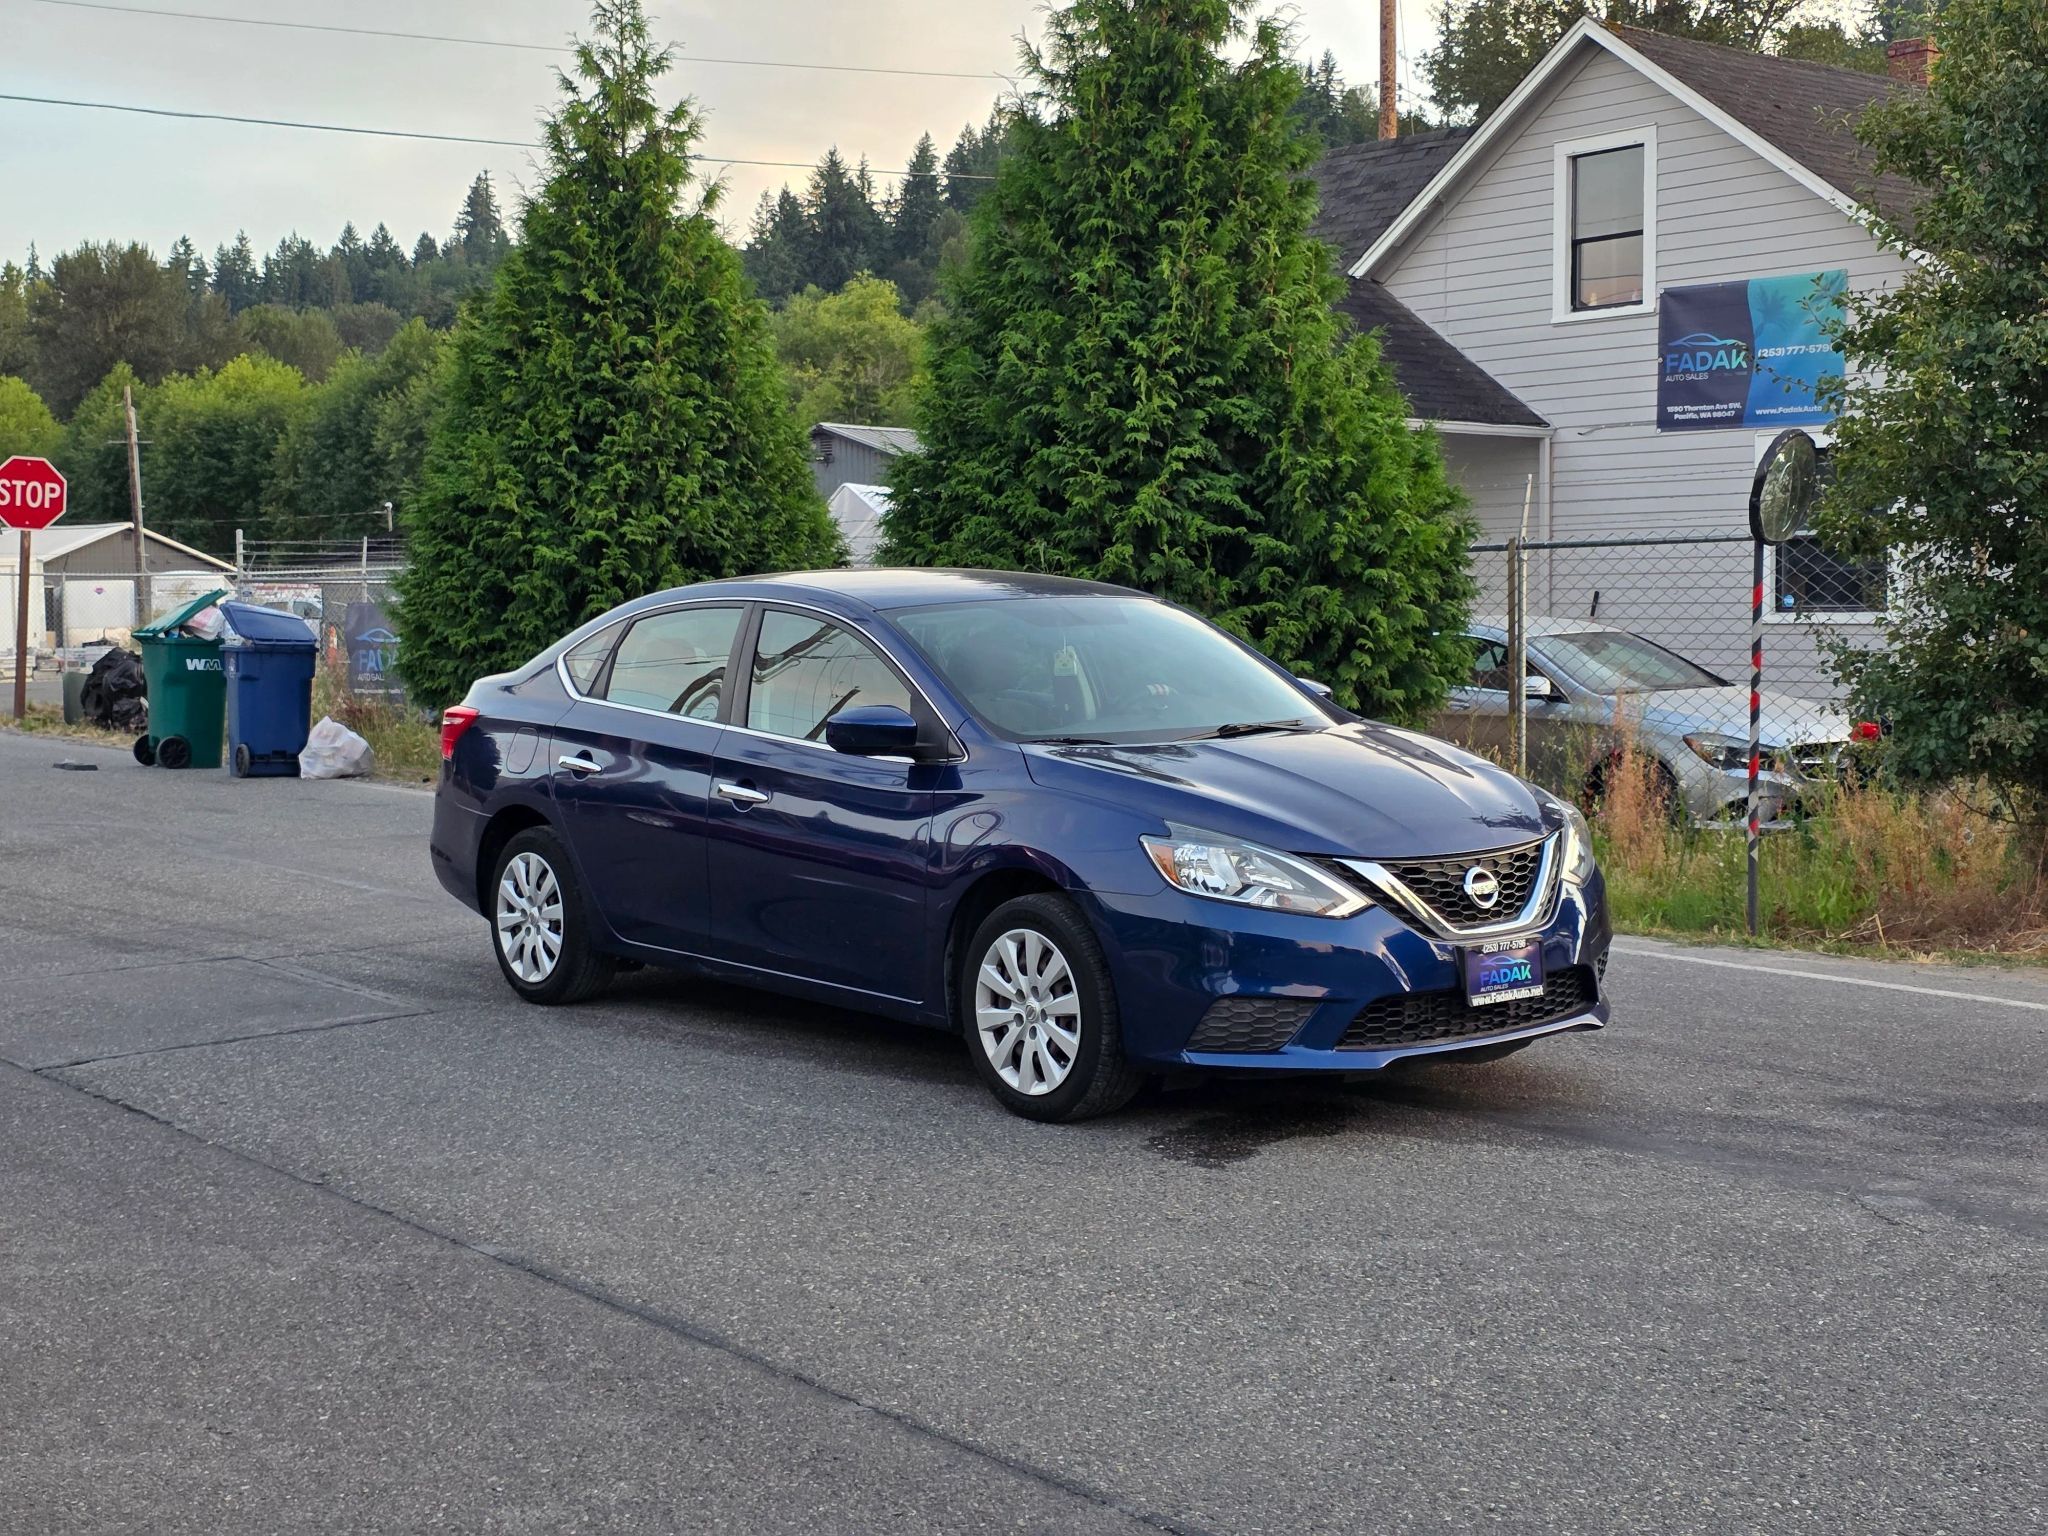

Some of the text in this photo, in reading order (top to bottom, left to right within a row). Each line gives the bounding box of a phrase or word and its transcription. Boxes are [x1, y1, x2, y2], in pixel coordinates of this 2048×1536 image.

[1758, 343, 1833, 357] (253) 777-579
[1666, 349, 1747, 373] FADAK
[1665, 372, 1709, 382] AUTO SALES
[1684, 404, 1715, 412] Thornton
[1755, 405, 1822, 415] www.FadakAuto
[0, 479, 61, 508] STOP
[186, 658, 222, 671] WM
[1483, 939, 1526, 954] (253) 777-5796
[1480, 965, 1532, 986] FADAK
[1471, 985, 1544, 1007] www.FadakAuto.net
